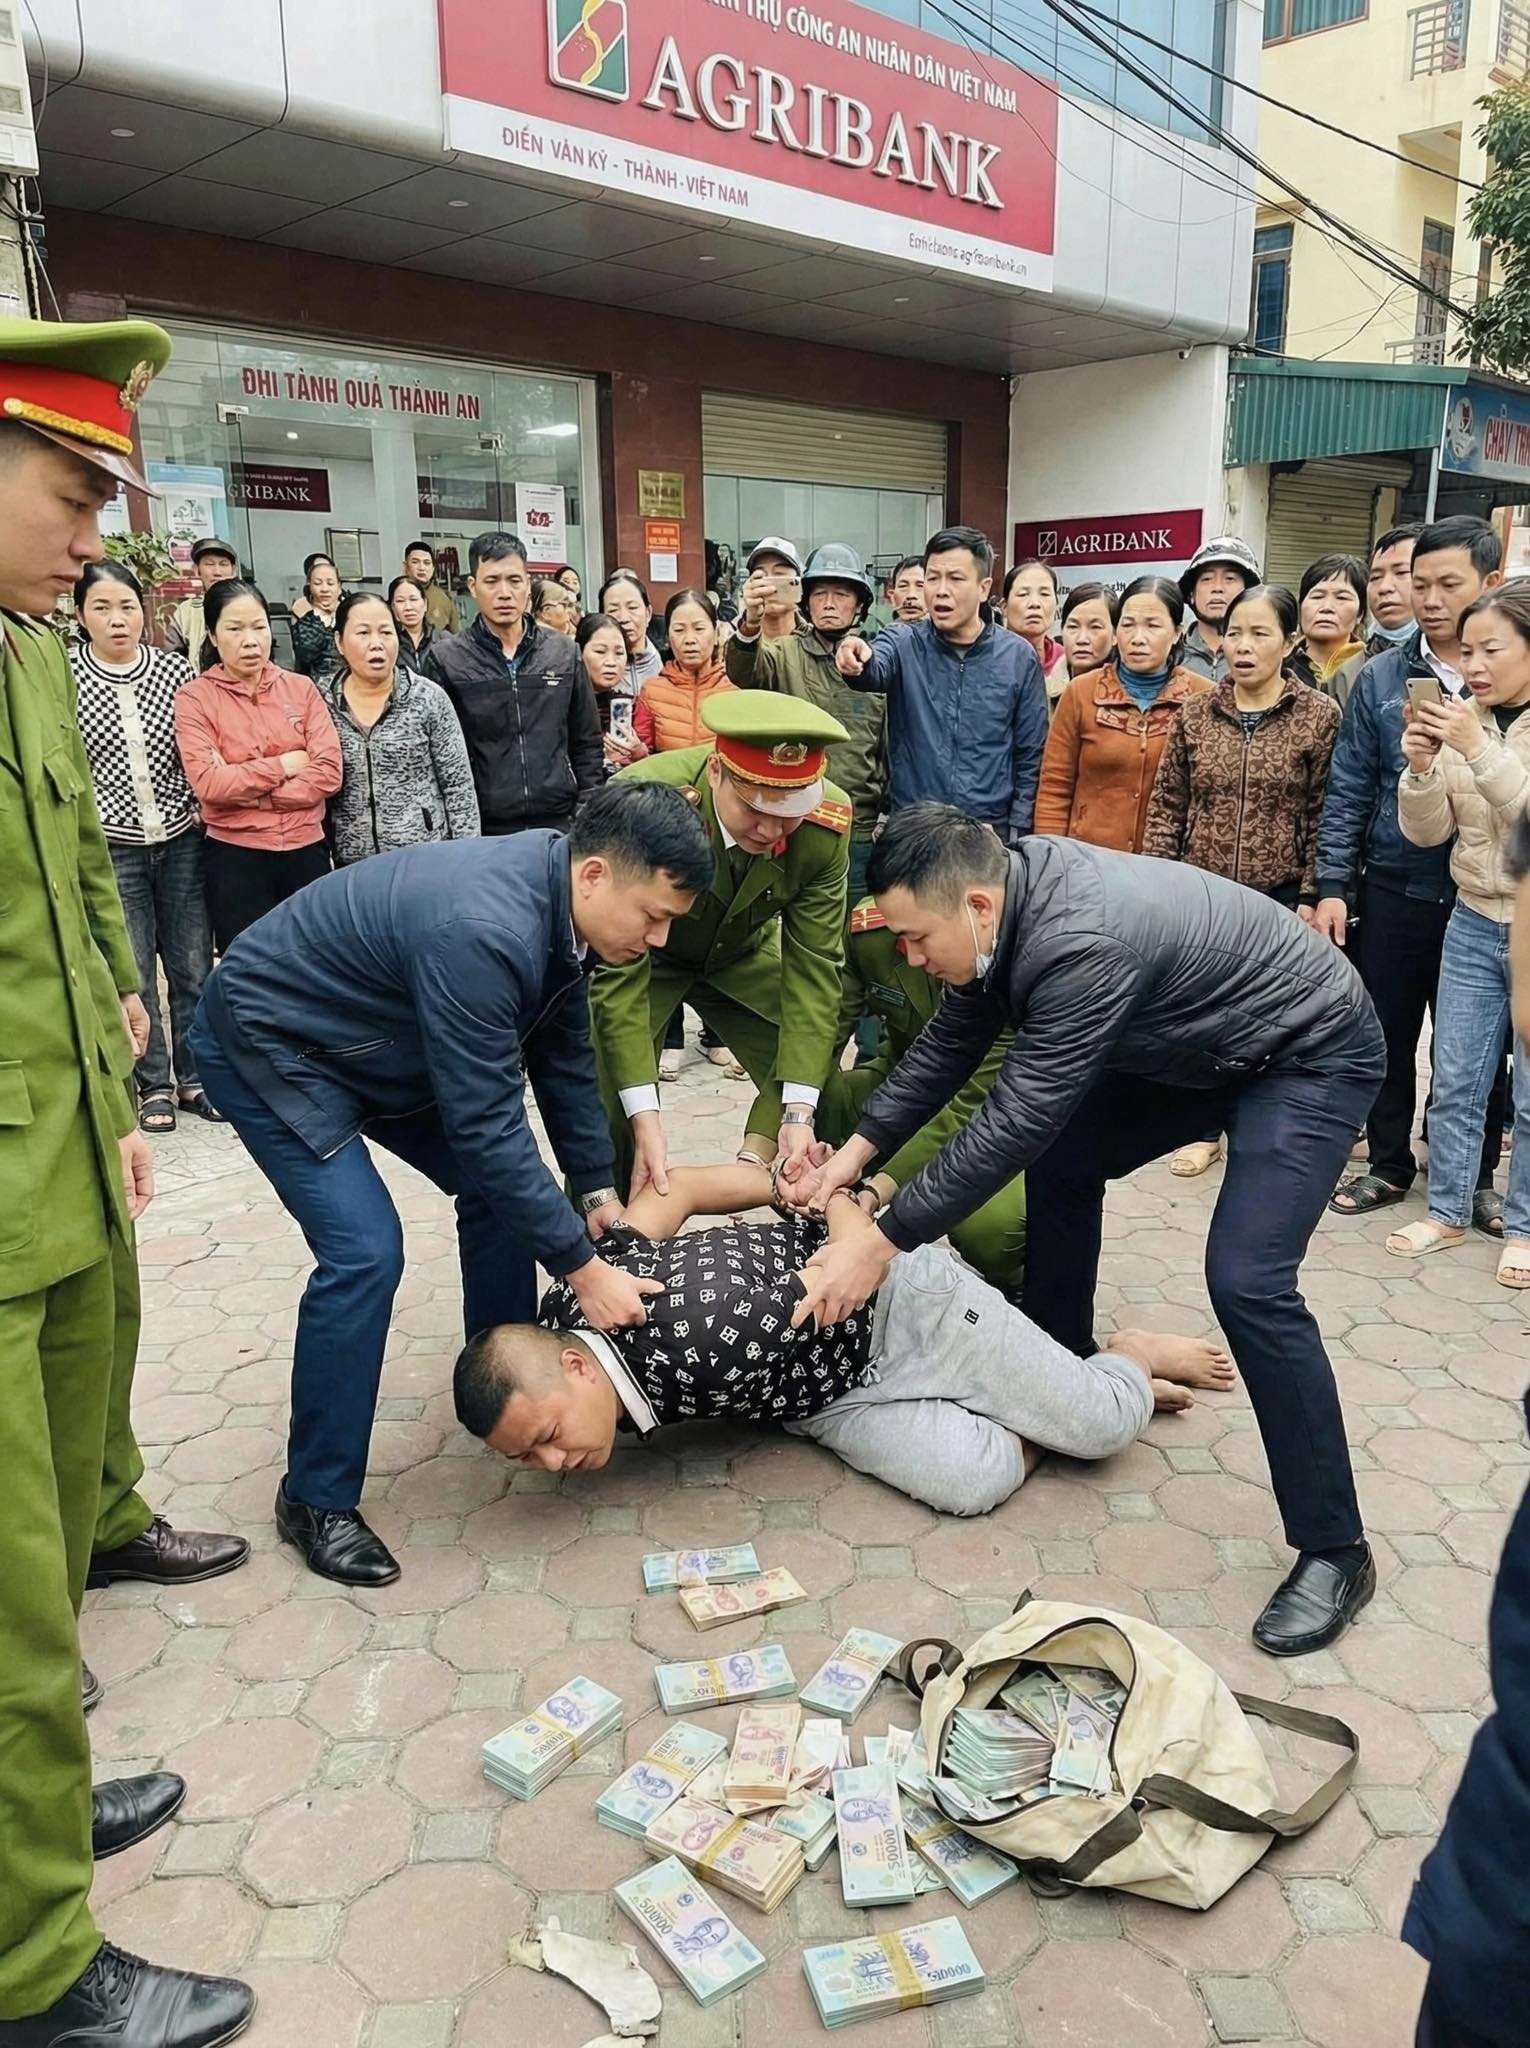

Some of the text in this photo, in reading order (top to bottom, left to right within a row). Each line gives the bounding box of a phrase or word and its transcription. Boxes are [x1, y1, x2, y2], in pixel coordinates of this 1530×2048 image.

[786, 6, 833, 46] CÔNG
[837, 26, 861, 57] AN
[865, 36, 910, 75] NHÂN
[915, 55, 946, 88] DÂN
[950, 67, 981, 103] VIỆT
[984, 82, 1017, 113] NAM
[640, 34, 1005, 210] AGRIBANK
[686, 176, 715, 200] VIỆT
[719, 184, 748, 207] NAM
[456, 394, 480, 419] AN
[227, 484, 312, 502] GRIBANK
[1060, 529, 1172, 555] AGRIBANK
